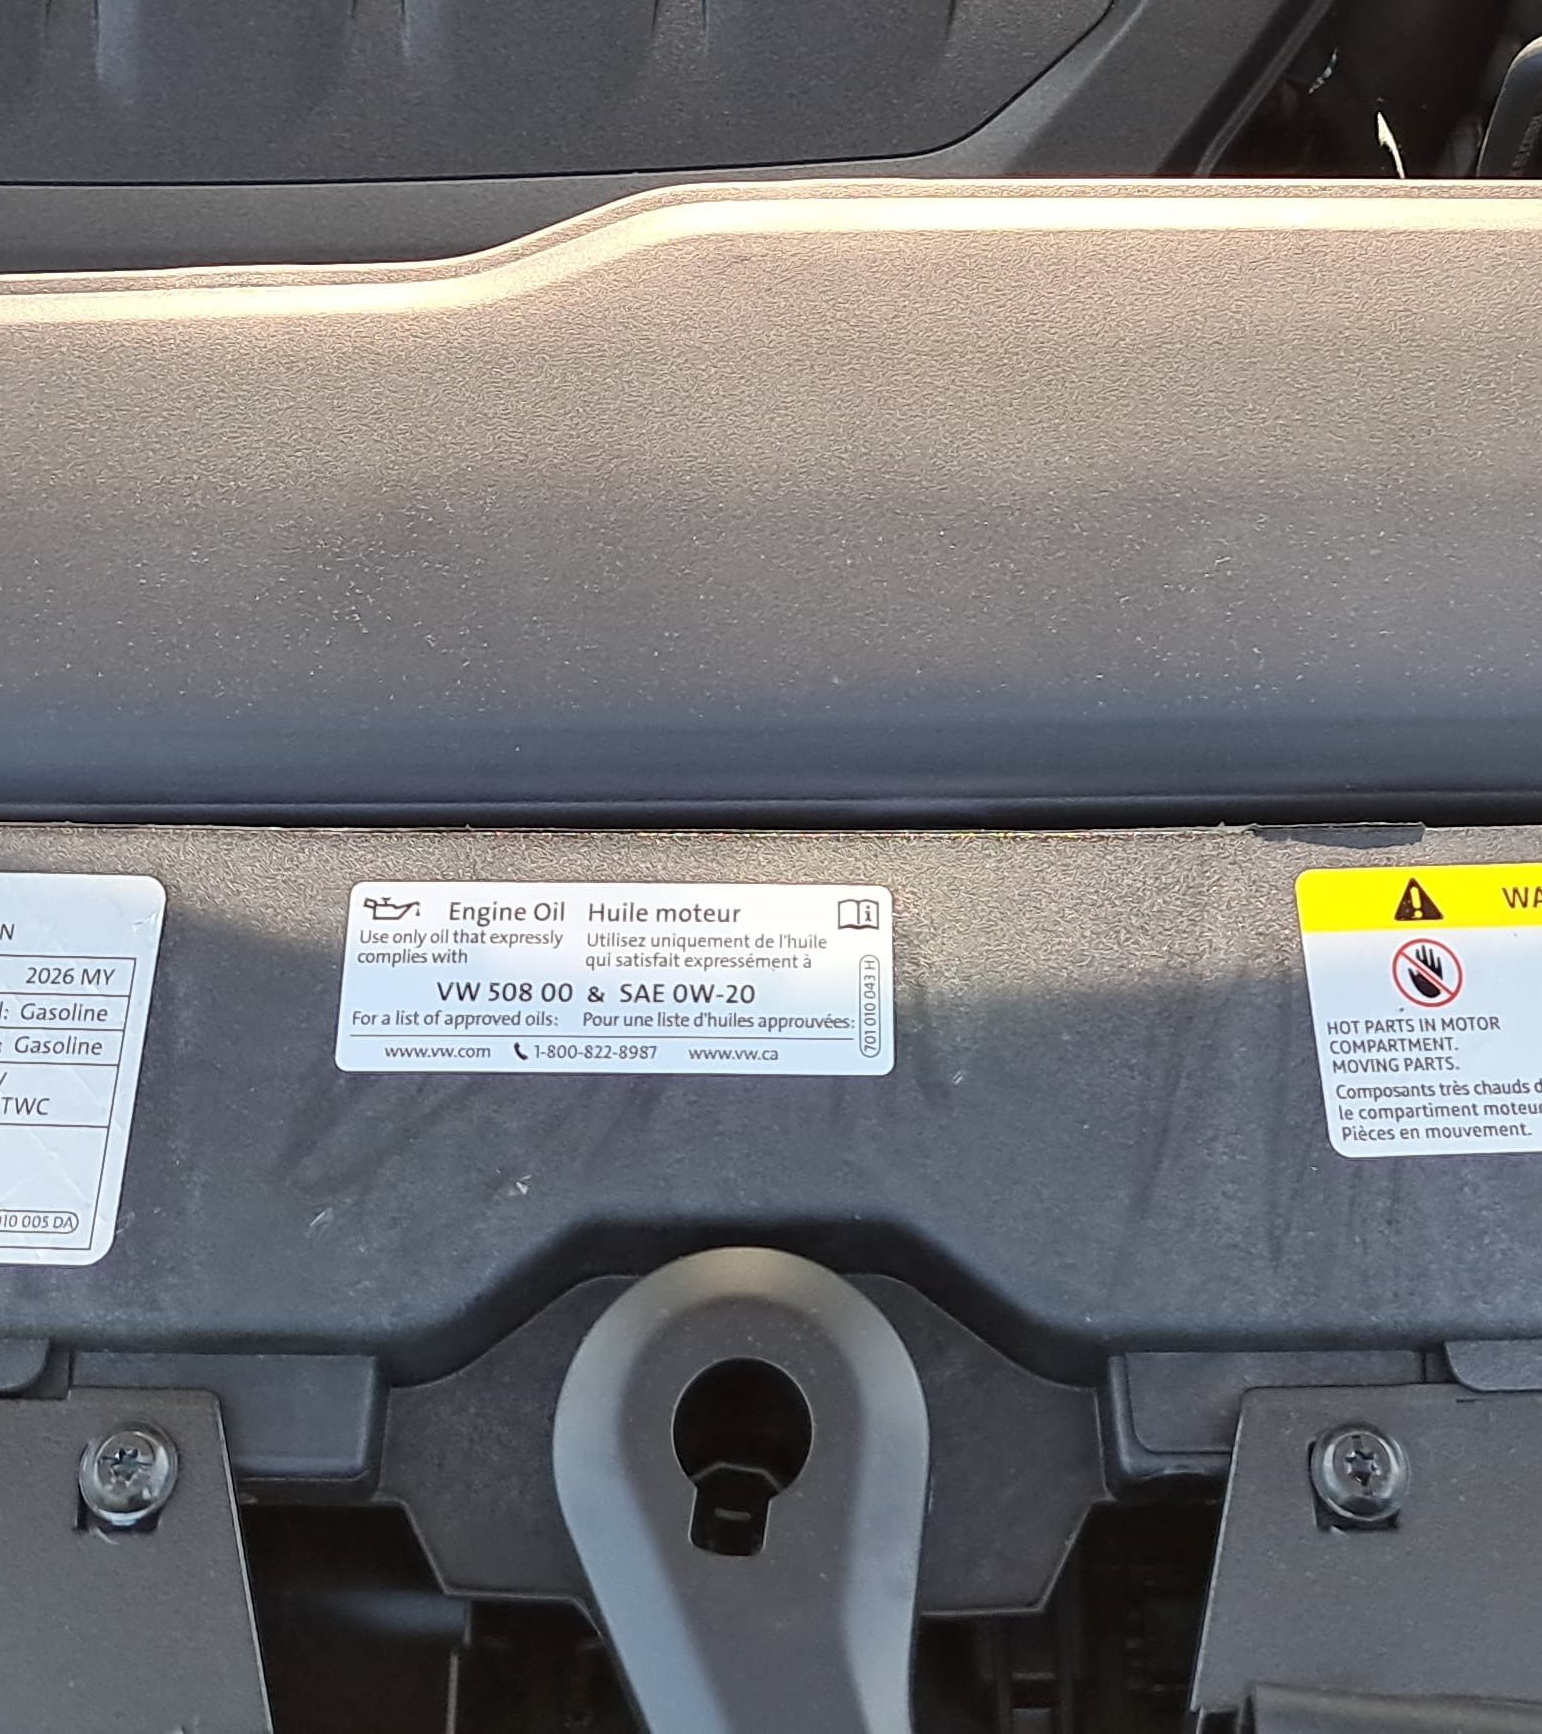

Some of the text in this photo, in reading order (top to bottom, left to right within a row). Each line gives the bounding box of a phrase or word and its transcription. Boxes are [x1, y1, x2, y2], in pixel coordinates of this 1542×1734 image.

[448, 900, 565, 928] Engine Oil
[587, 901, 741, 923] Huile moteur
[358, 927, 564, 950] Use only oil that expressly
[586, 931, 646, 948] Utilisez
[649, 931, 751, 952] uniquement
[753, 932, 775, 949] de
[356, 947, 468, 969] complies with
[584, 950, 812, 972] qui satisfait expressément à
[24, 965, 116, 986] 2026 MY
[435, 980, 756, 1004] VW 508 00 & SAE 0W-20
[19, 1001, 108, 1022] Gasoline
[351, 1008, 559, 1031] For a list of approved oils:
[581, 1010, 620, 1027] Pour
[622, 1014, 654, 1028] une
[656, 1010, 690, 1028] liste
[756, 1012, 855, 1033] approuvées:
[1325, 1015, 1501, 1036] HOT PARTS IN MOTOR
[13, 1034, 103, 1056] Gasoline
[383, 1046, 491, 1059] www.vw.com
[533, 1043, 658, 1060] 1-800-822-8987
[687, 1048, 779, 1061] www.vw.ca
[1328, 1035, 1459, 1055] COMPARTMENT.
[1331, 1055, 1460, 1074] MOVING PARTS.
[1334, 1082, 1436, 1103] Composants
[1437, 1079, 1471, 1097] très
[1472, 1077, 1531, 1096] chauds
[1340, 1122, 1533, 1142] Pièces en mouvement.
